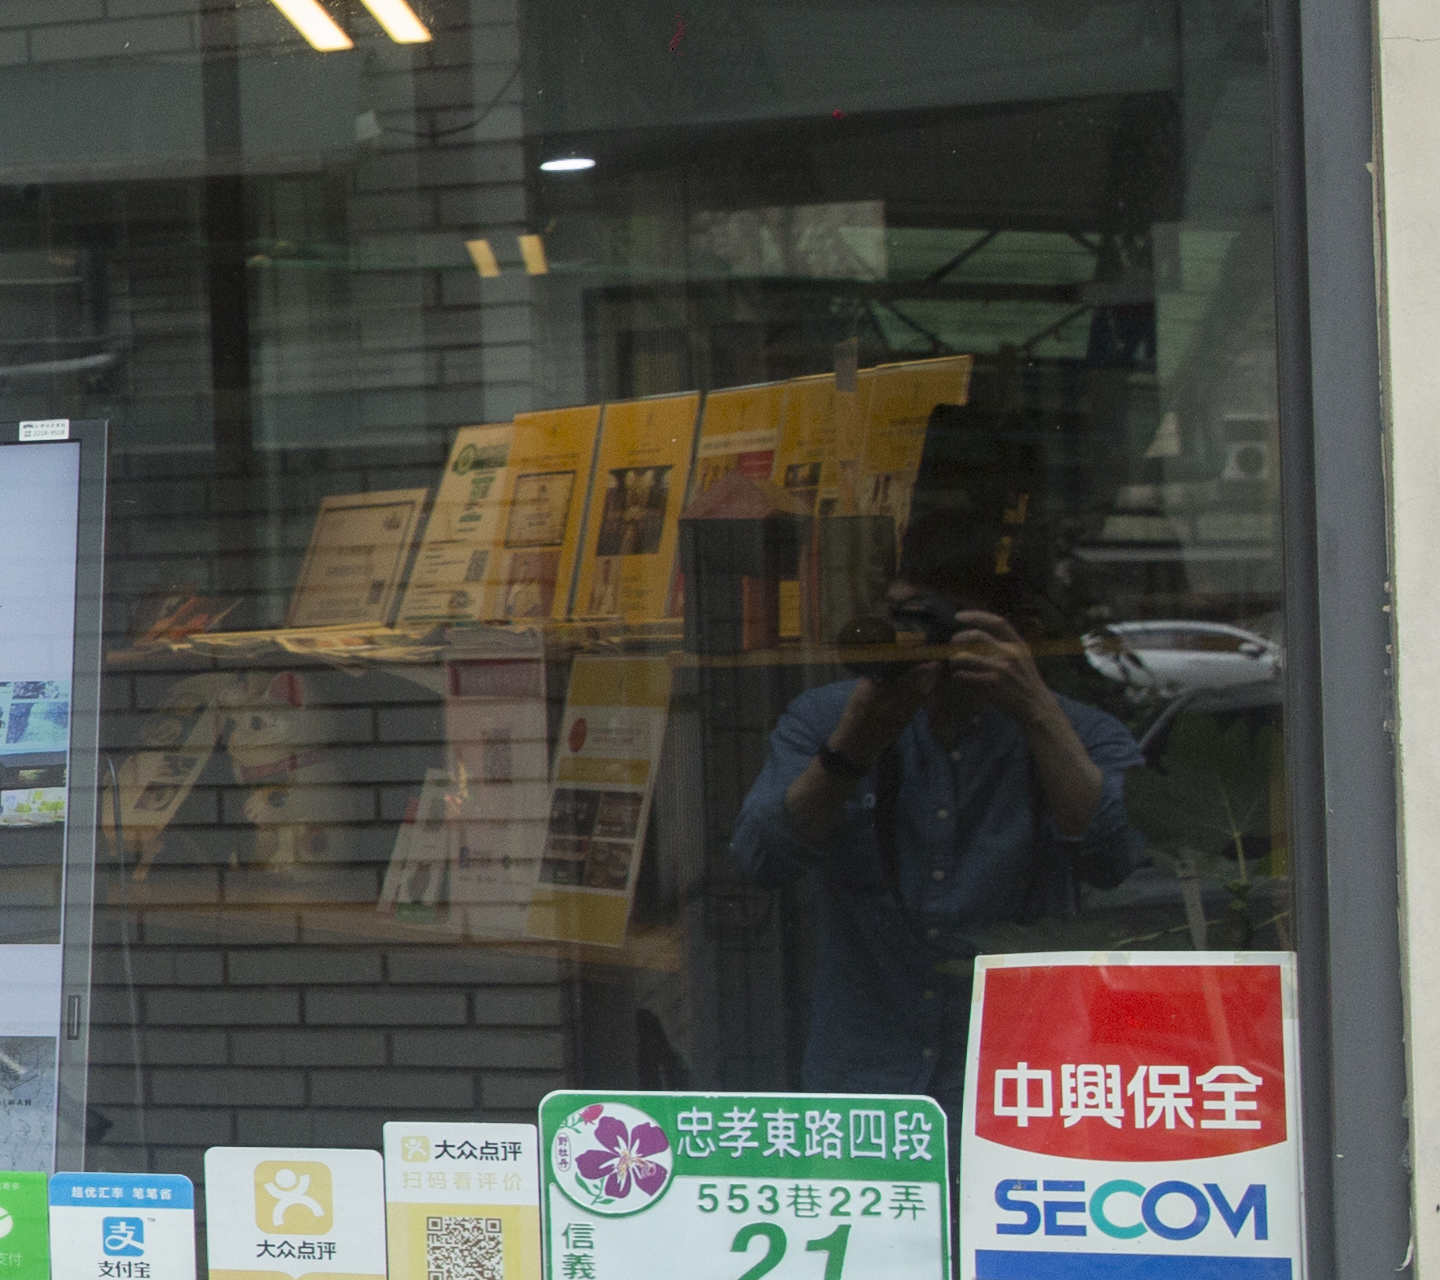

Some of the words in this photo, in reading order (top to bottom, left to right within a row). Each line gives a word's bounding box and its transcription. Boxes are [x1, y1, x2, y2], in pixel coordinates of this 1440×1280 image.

[993, 1062, 1265, 1131] 中興保全
[676, 1107, 933, 1161] 忠孝東路四段
[434, 1140, 523, 1162] 大众点评
[402, 1170, 524, 1192] 扫码看评价
[71, 1186, 124, 1199] 超优汇率
[133, 1187, 173, 1201] 笔笔省
[698, 1183, 927, 1220] 553巷22弄
[994, 1178, 1268, 1241] SECOM
[256, 1239, 337, 1261] 大众点评
[97, 1260, 151, 1279] 支付宝
